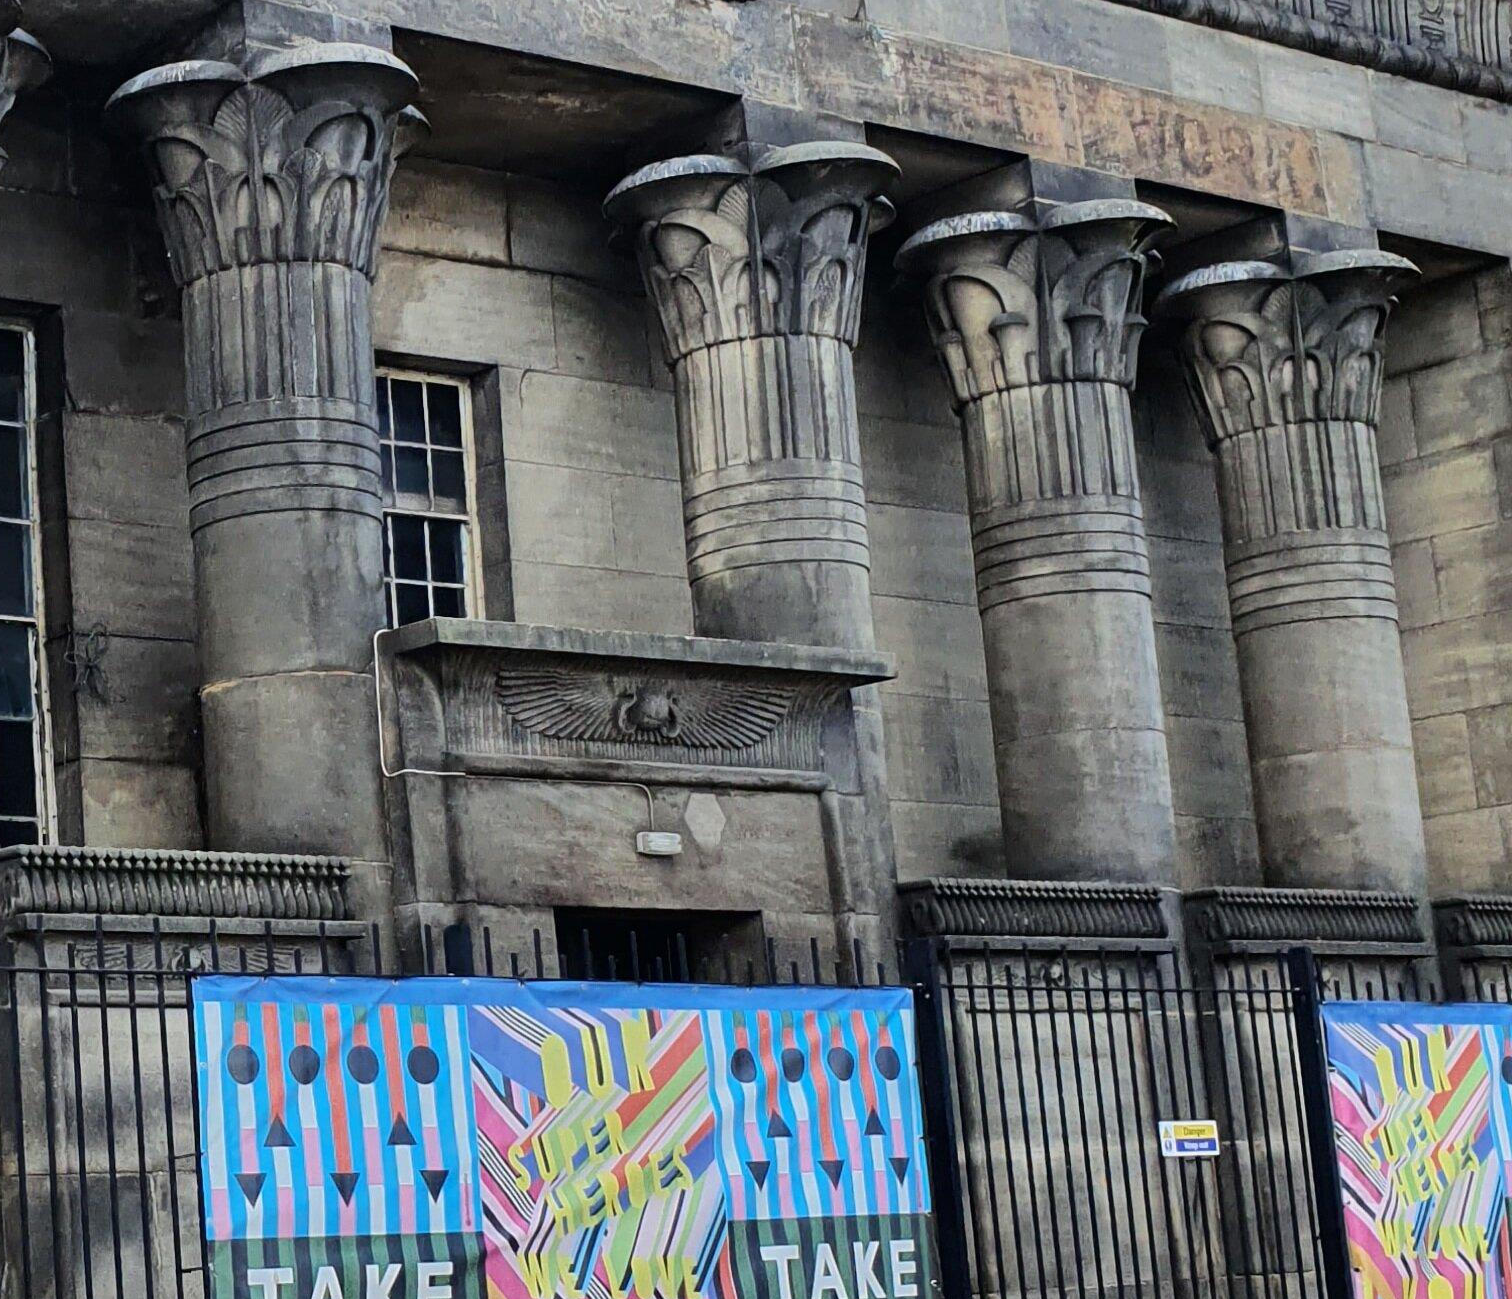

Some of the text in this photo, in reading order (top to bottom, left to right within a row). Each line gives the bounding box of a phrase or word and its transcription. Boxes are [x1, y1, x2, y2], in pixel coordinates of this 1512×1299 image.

[541, 1019, 655, 1110] OUR
[1375, 1033, 1452, 1106] OUR
[508, 1110, 628, 1191] SUPER
[545, 1143, 694, 1238] HEROES
[517, 1254, 586, 1299] WE
[1376, 1219, 1491, 1262] WE LOVE
